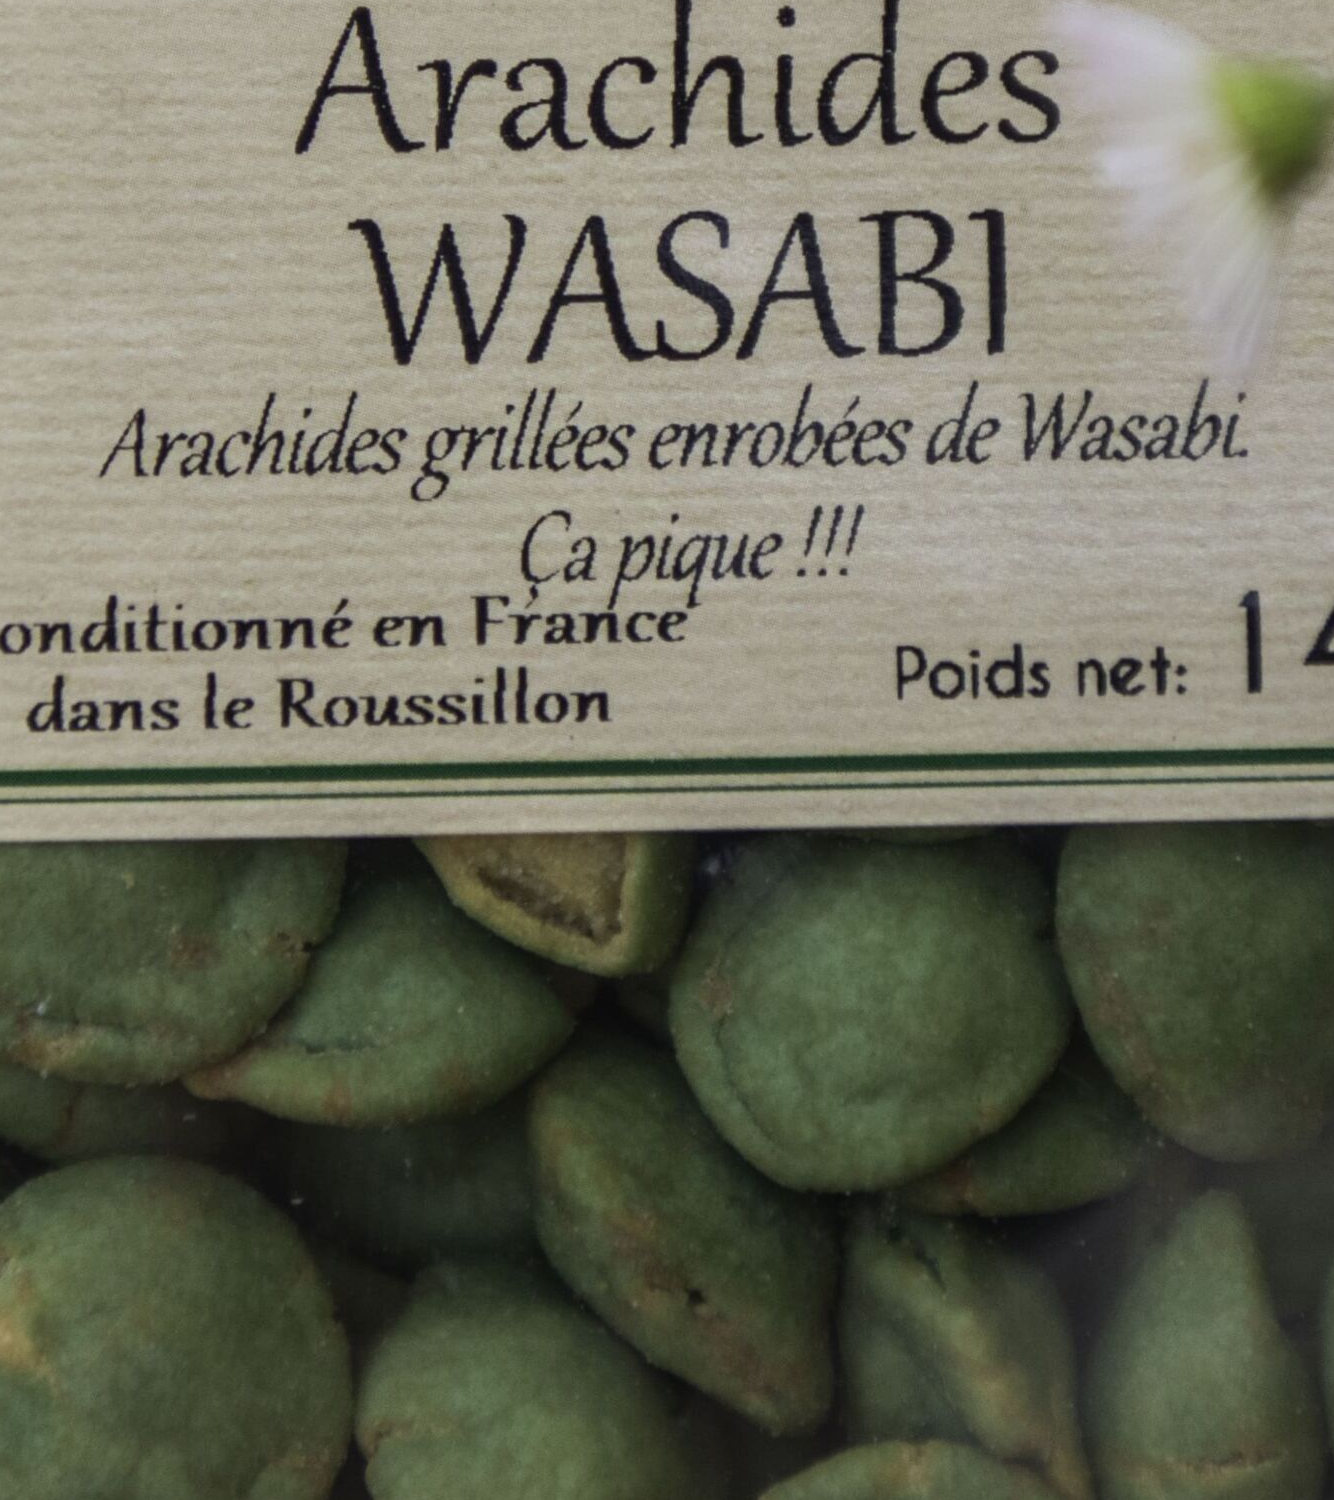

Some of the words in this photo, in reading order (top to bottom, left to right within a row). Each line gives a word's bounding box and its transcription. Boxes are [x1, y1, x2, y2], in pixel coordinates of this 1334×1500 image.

[347, 206, 1007, 365] WASABI
[99, 390, 407, 478] Arachides
[409, 388, 638, 502] grillées
[649, 383, 911, 468] enrobées
[926, 379, 1003, 463] de
[1019, 378, 1250, 462] Wasabi.
[520, 511, 597, 598] Ça
[609, 512, 782, 606] pique
[797, 504, 865, 578] !!!
[372, 607, 446, 648] en
[470, 594, 687, 646] France
[26, 674, 180, 734] dans
[204, 672, 255, 731] le
[277, 666, 611, 727] Roussillon
[895, 643, 1051, 700] Poids
[1075, 645, 1188, 697] net:
